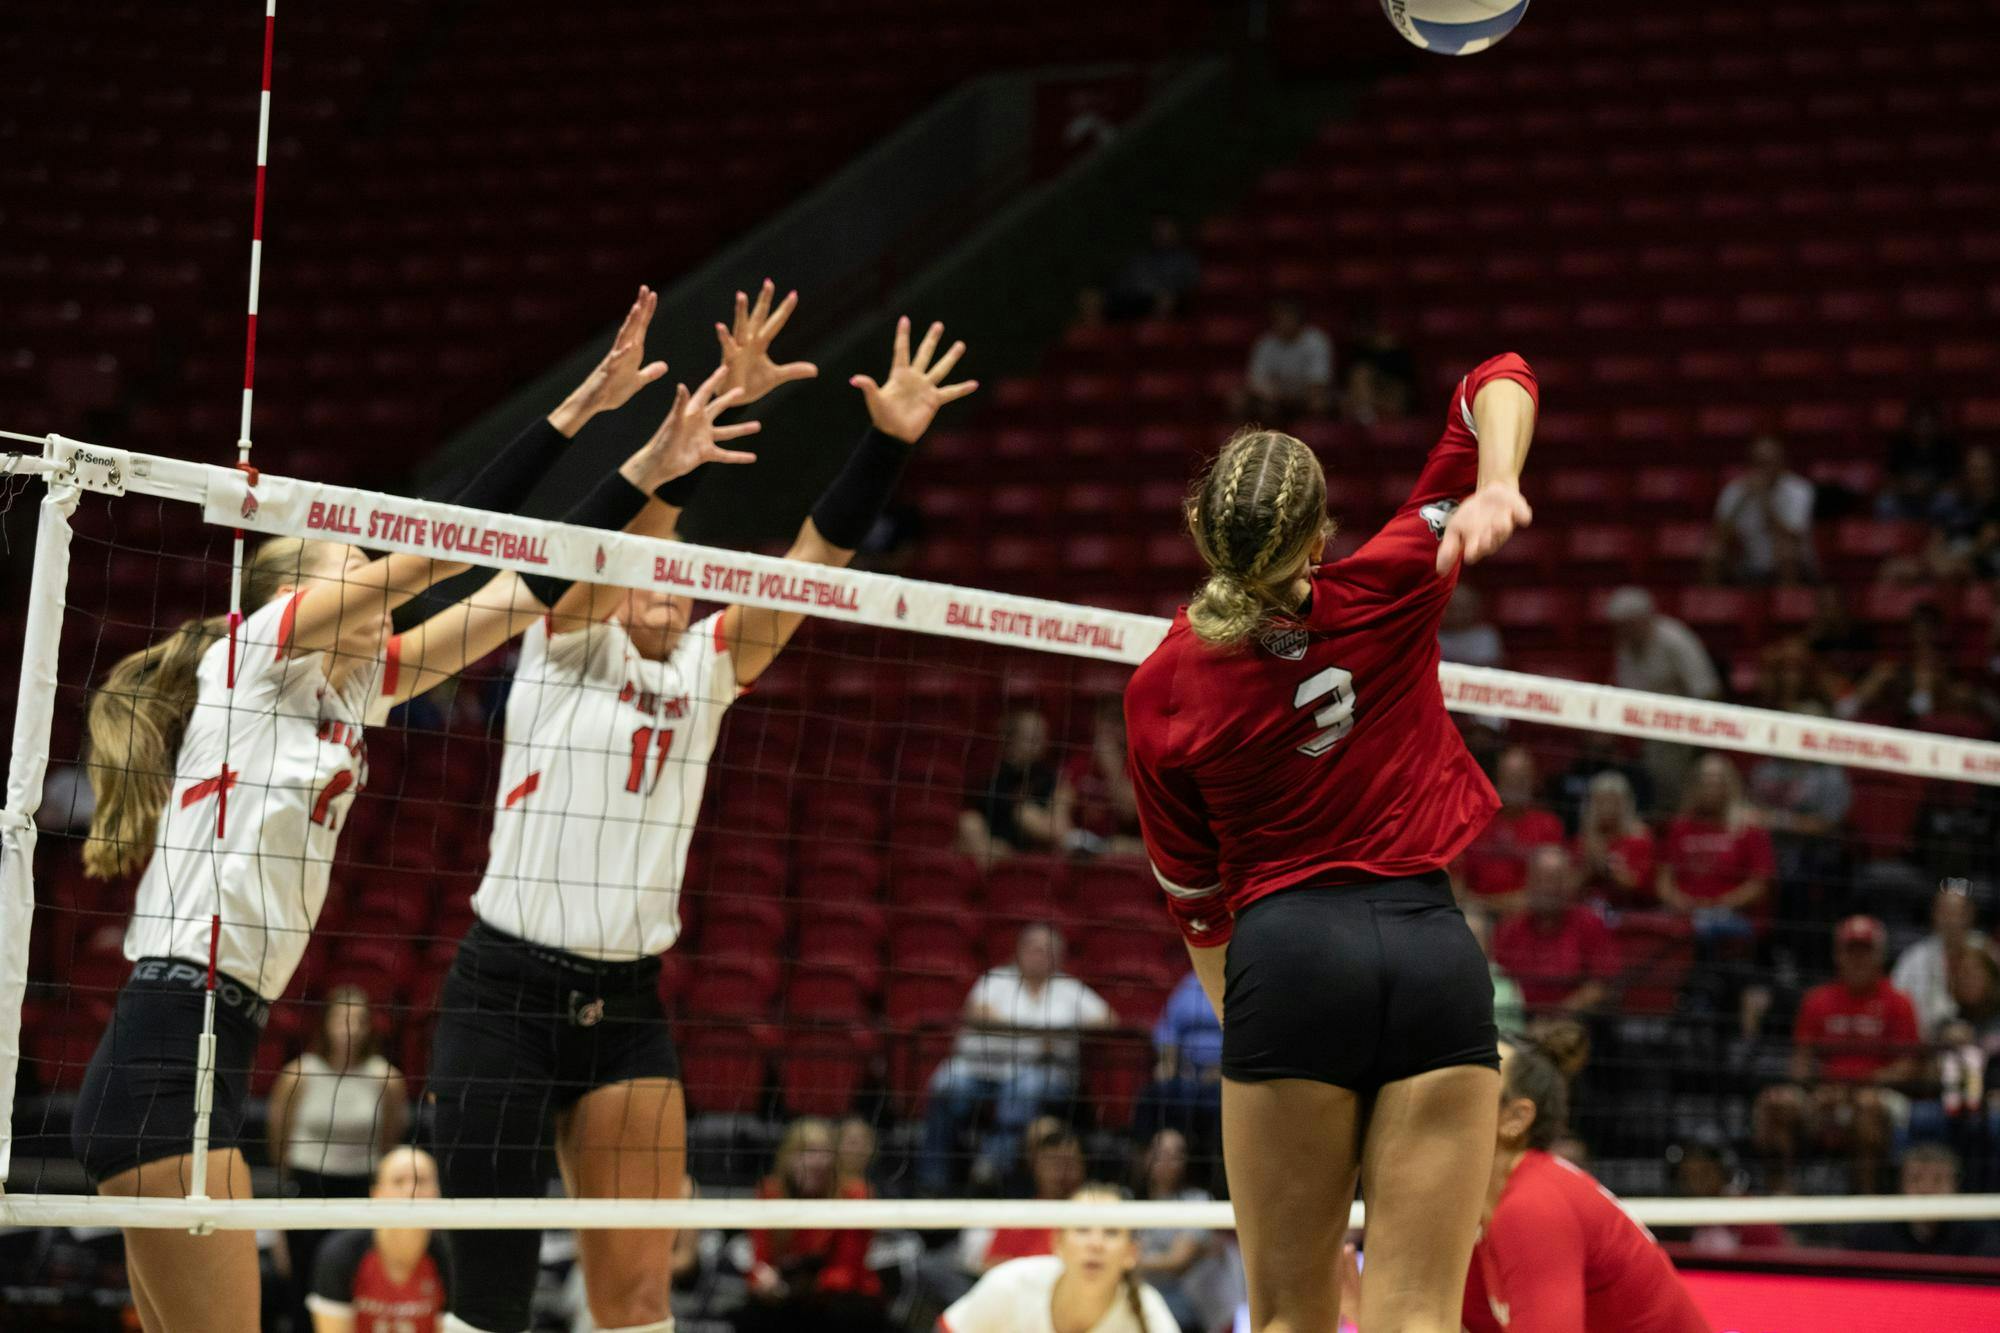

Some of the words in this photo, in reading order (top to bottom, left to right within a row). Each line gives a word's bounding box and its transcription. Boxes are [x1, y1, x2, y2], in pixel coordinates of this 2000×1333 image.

[84, 452, 116, 467] Senoh
[307, 502, 361, 535] BALL
[367, 510, 427, 545] STATE
[432, 520, 549, 564] VOLLEYBALL
[653, 556, 696, 587] BALL
[701, 564, 751, 595] STATE
[758, 572, 859, 611] VOLLEYBALL
[946, 602, 985, 629] BALL
[990, 609, 1033, 637] STATE
[1293, 666, 1357, 758] 3
